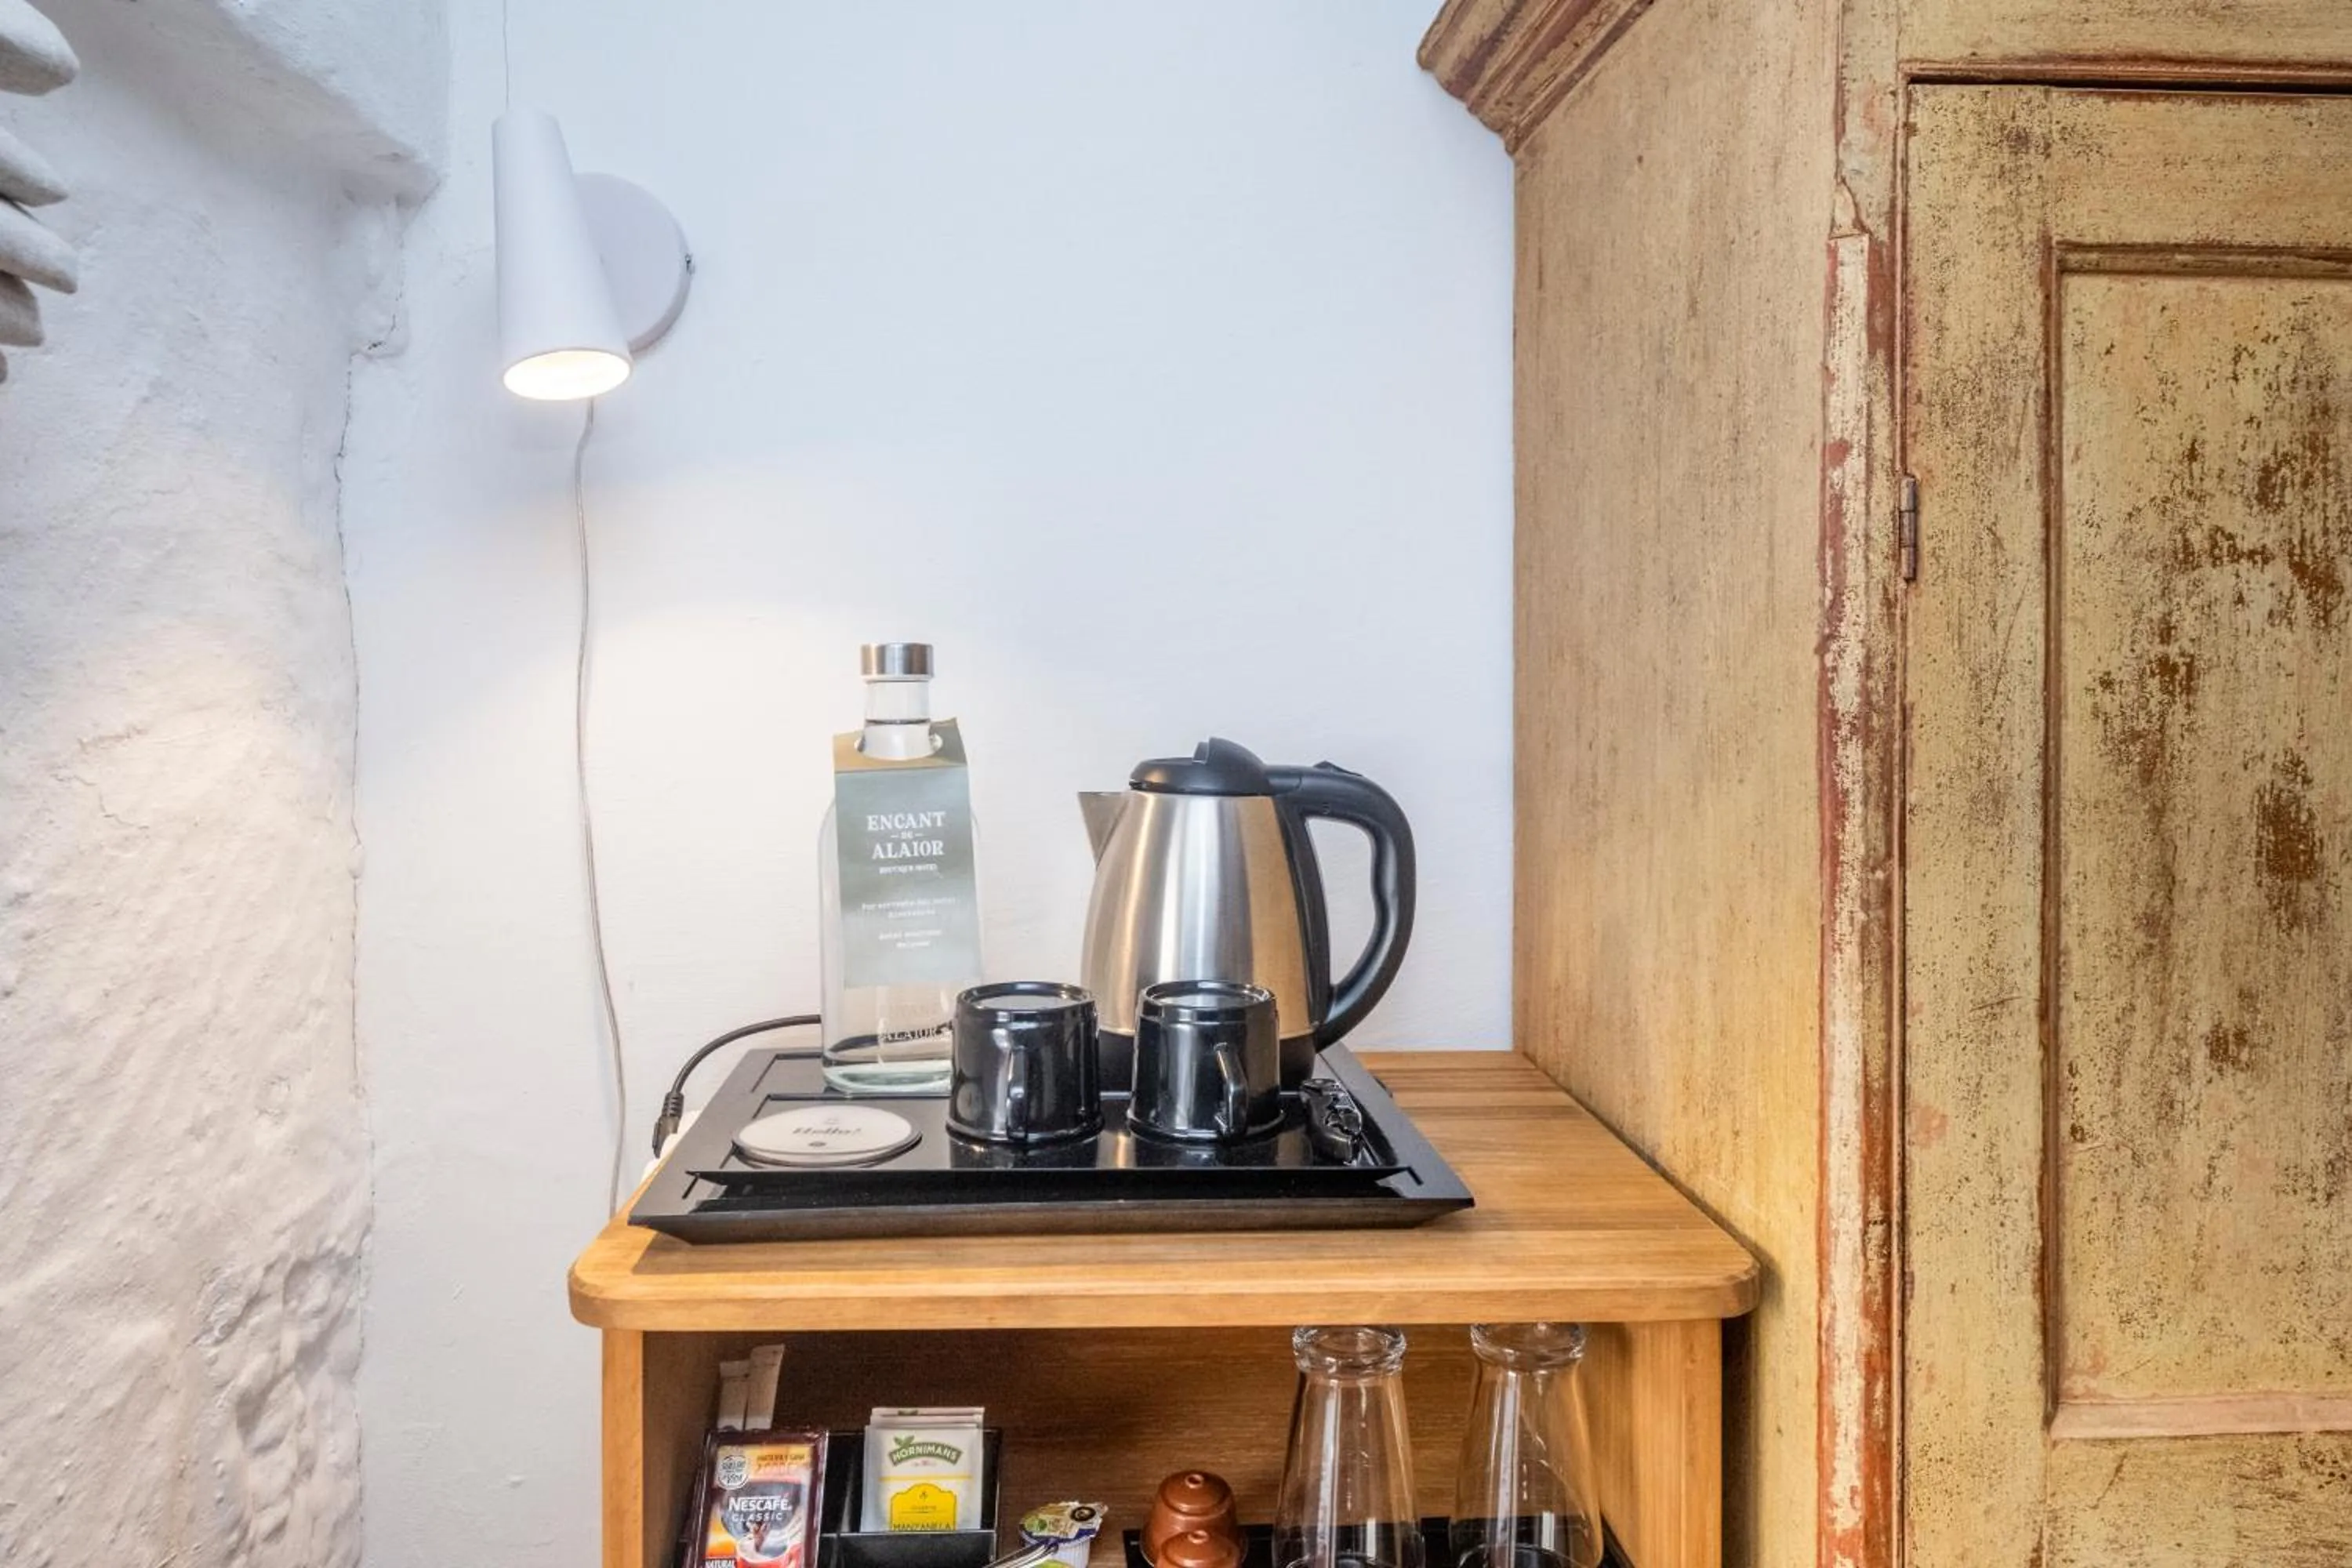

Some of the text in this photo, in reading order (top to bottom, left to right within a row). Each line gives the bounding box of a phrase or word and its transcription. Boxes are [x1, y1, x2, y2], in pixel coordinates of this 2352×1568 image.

[866, 811, 946, 831] ENCANT
[872, 840, 945, 859] ALAIOR
[892, 1445, 958, 1463] HORNIMANS
[731, 1512, 783, 1522] CLASSIC
